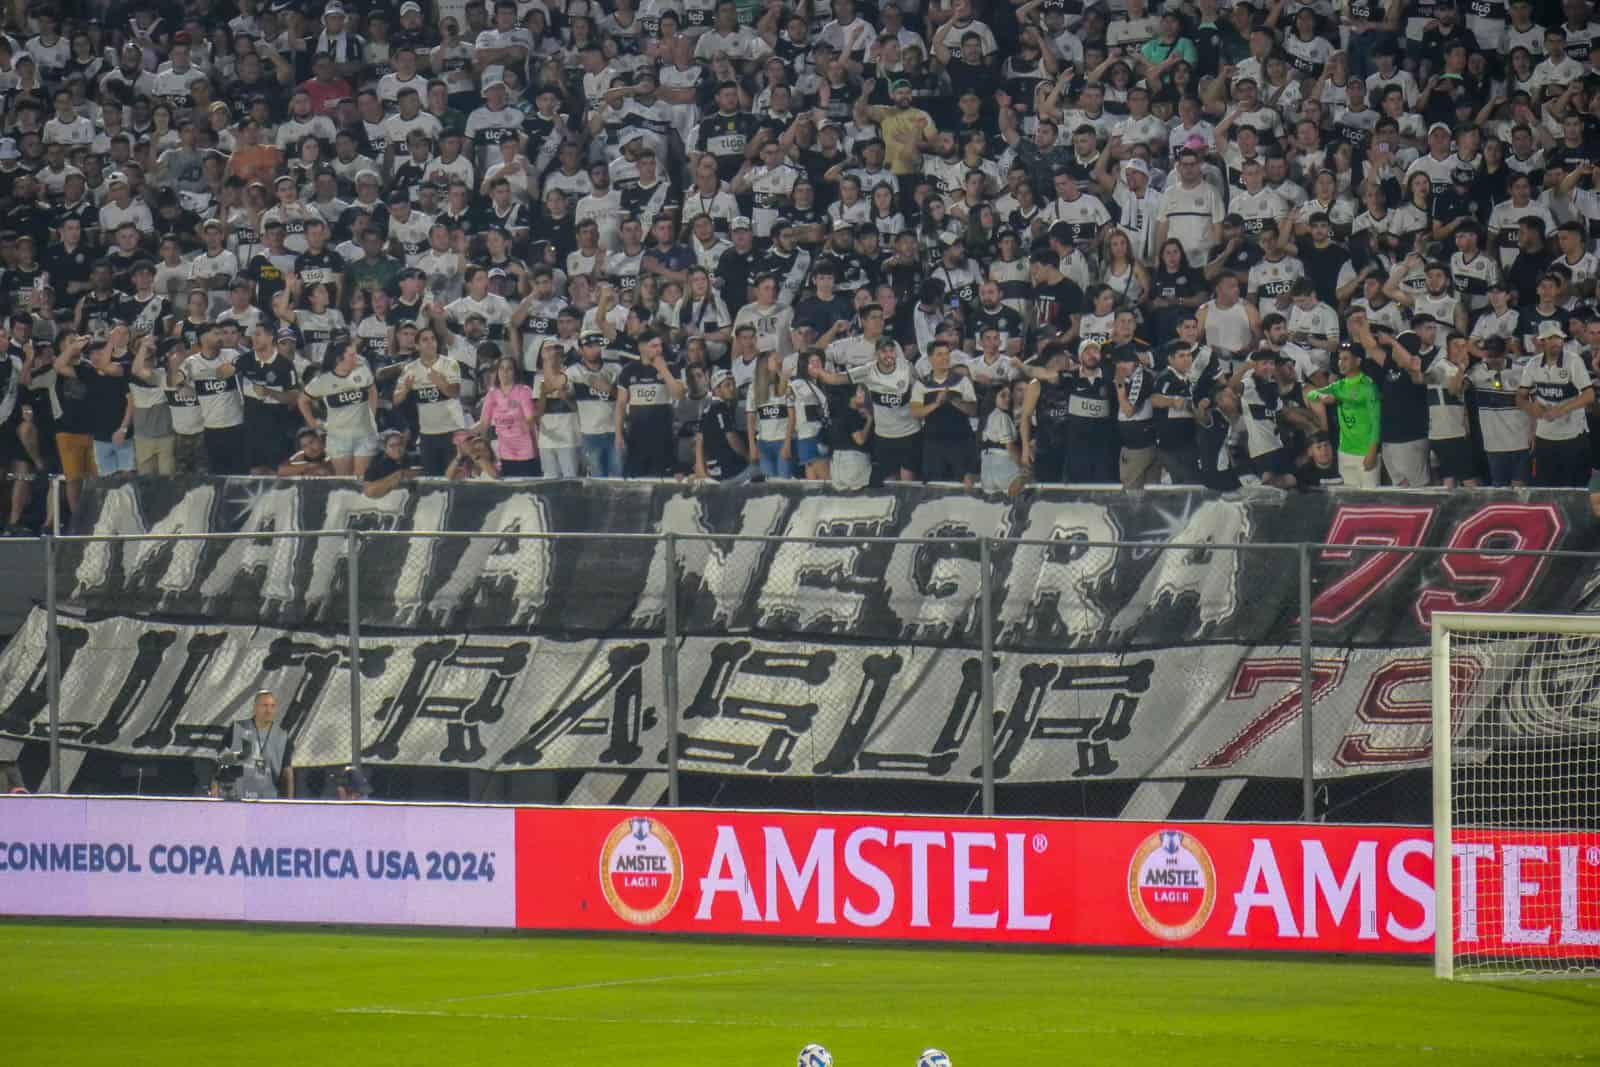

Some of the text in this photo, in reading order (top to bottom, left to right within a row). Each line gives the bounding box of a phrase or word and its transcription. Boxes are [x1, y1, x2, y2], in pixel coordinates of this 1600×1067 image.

[204, 380, 226, 393] tigo
[636, 388, 656, 401] tigo
[338, 391, 362, 404] tigo
[761, 407, 779, 418] tigo
[70, 482, 1565, 642] MAFIA NEGRA 79
[149, 844, 225, 875] COPA
[229, 846, 359, 880] AMERICA
[366, 850, 421, 880] USA
[426, 851, 496, 882] 2024
[616, 854, 667, 872] AMSTEL
[694, 824, 1053, 931] AMSTEL
[1144, 868, 1199, 887] AMSTEL
